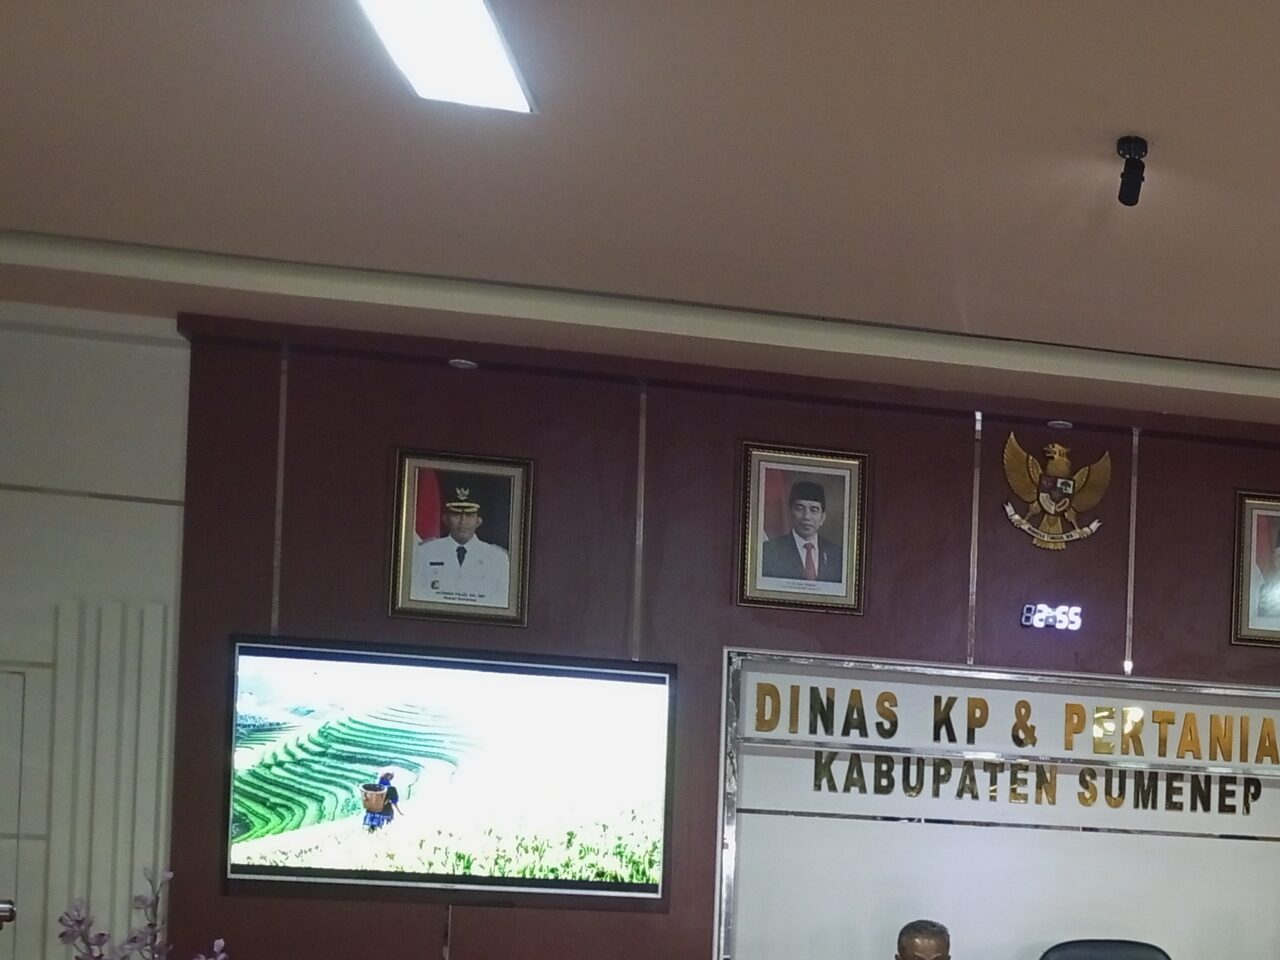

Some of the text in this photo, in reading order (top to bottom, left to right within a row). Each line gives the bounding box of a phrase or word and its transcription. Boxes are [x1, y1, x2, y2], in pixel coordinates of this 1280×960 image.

[755, 682, 898, 740] DINAS
[932, 694, 989, 745] KP
[1011, 699, 1038, 748] &
[812, 750, 1262, 816] KABUPATEN SUMENEP
